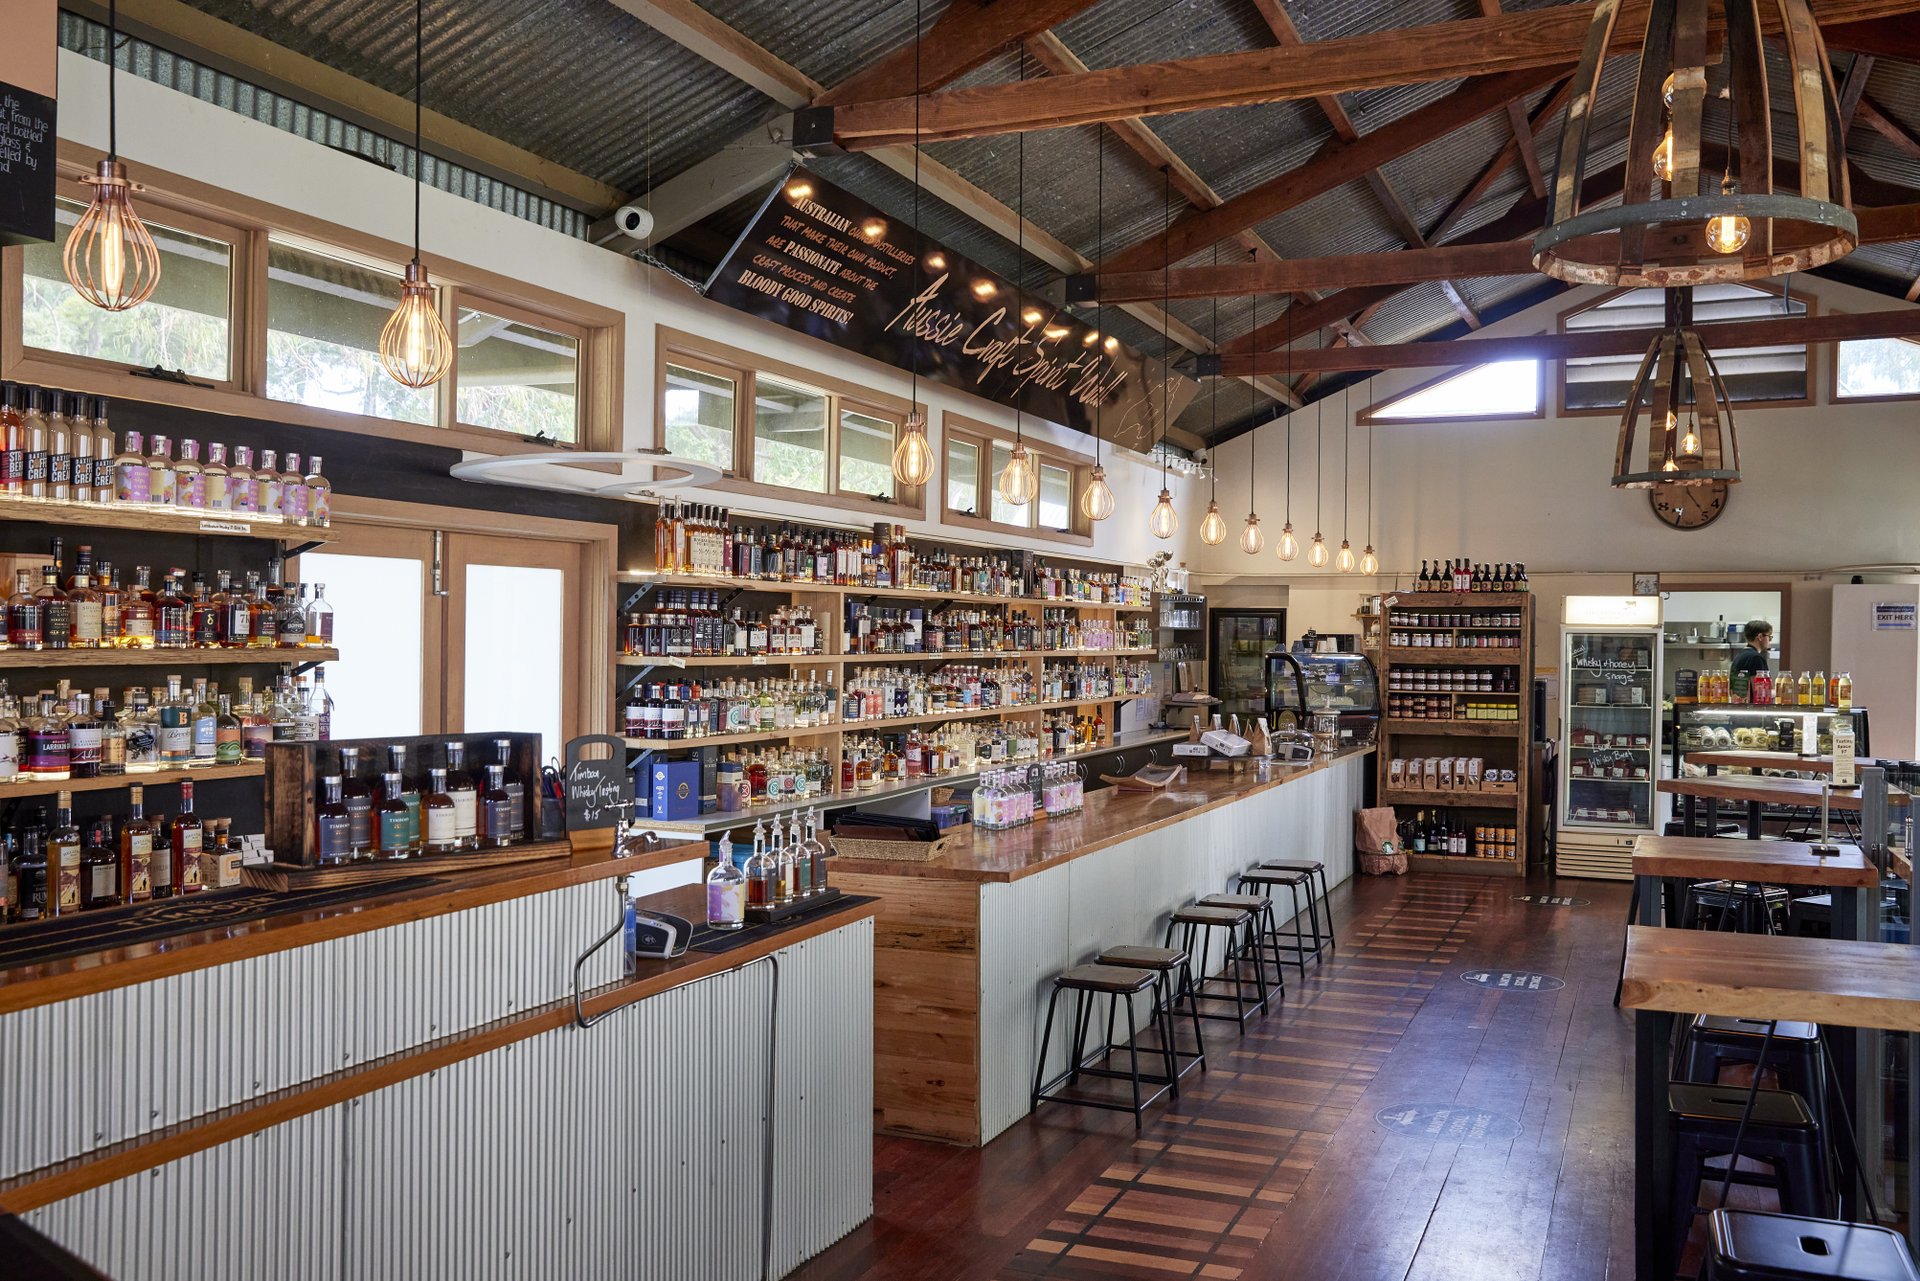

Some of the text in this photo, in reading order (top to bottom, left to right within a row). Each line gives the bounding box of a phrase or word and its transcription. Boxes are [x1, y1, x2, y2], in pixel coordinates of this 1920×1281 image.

[4, 94, 20, 111] the
[11, 110, 31, 127] from
[34, 117, 48, 133] the
[13, 125, 43, 144] bottled
[25, 152, 38, 171] by
[792, 198, 852, 233] AUSTRALIAN
[874, 240, 916, 265] DISTILLERIES
[780, 215, 897, 280] THAT MAKE THEIR OWN PRODUCT,
[766, 234, 878, 291] ARE PASSIONATE ABOUT THE
[752, 254, 856, 303] CRAFT PROCESS AND CREATE
[737, 269, 854, 324] BLOODY GOOD SPIRITS!
[884, 272, 1128, 407] Aussie Craft Spirit Wall
[1658, 502, 1669, 511] 8
[1711, 498, 1719, 509] 4
[1701, 511, 1708, 521] 5
[1576, 656, 1602, 678] Whisky
[1609, 658, 1635, 674] honey
[572, 784, 598, 809] Whisky
[584, 808, 601, 821] $15
